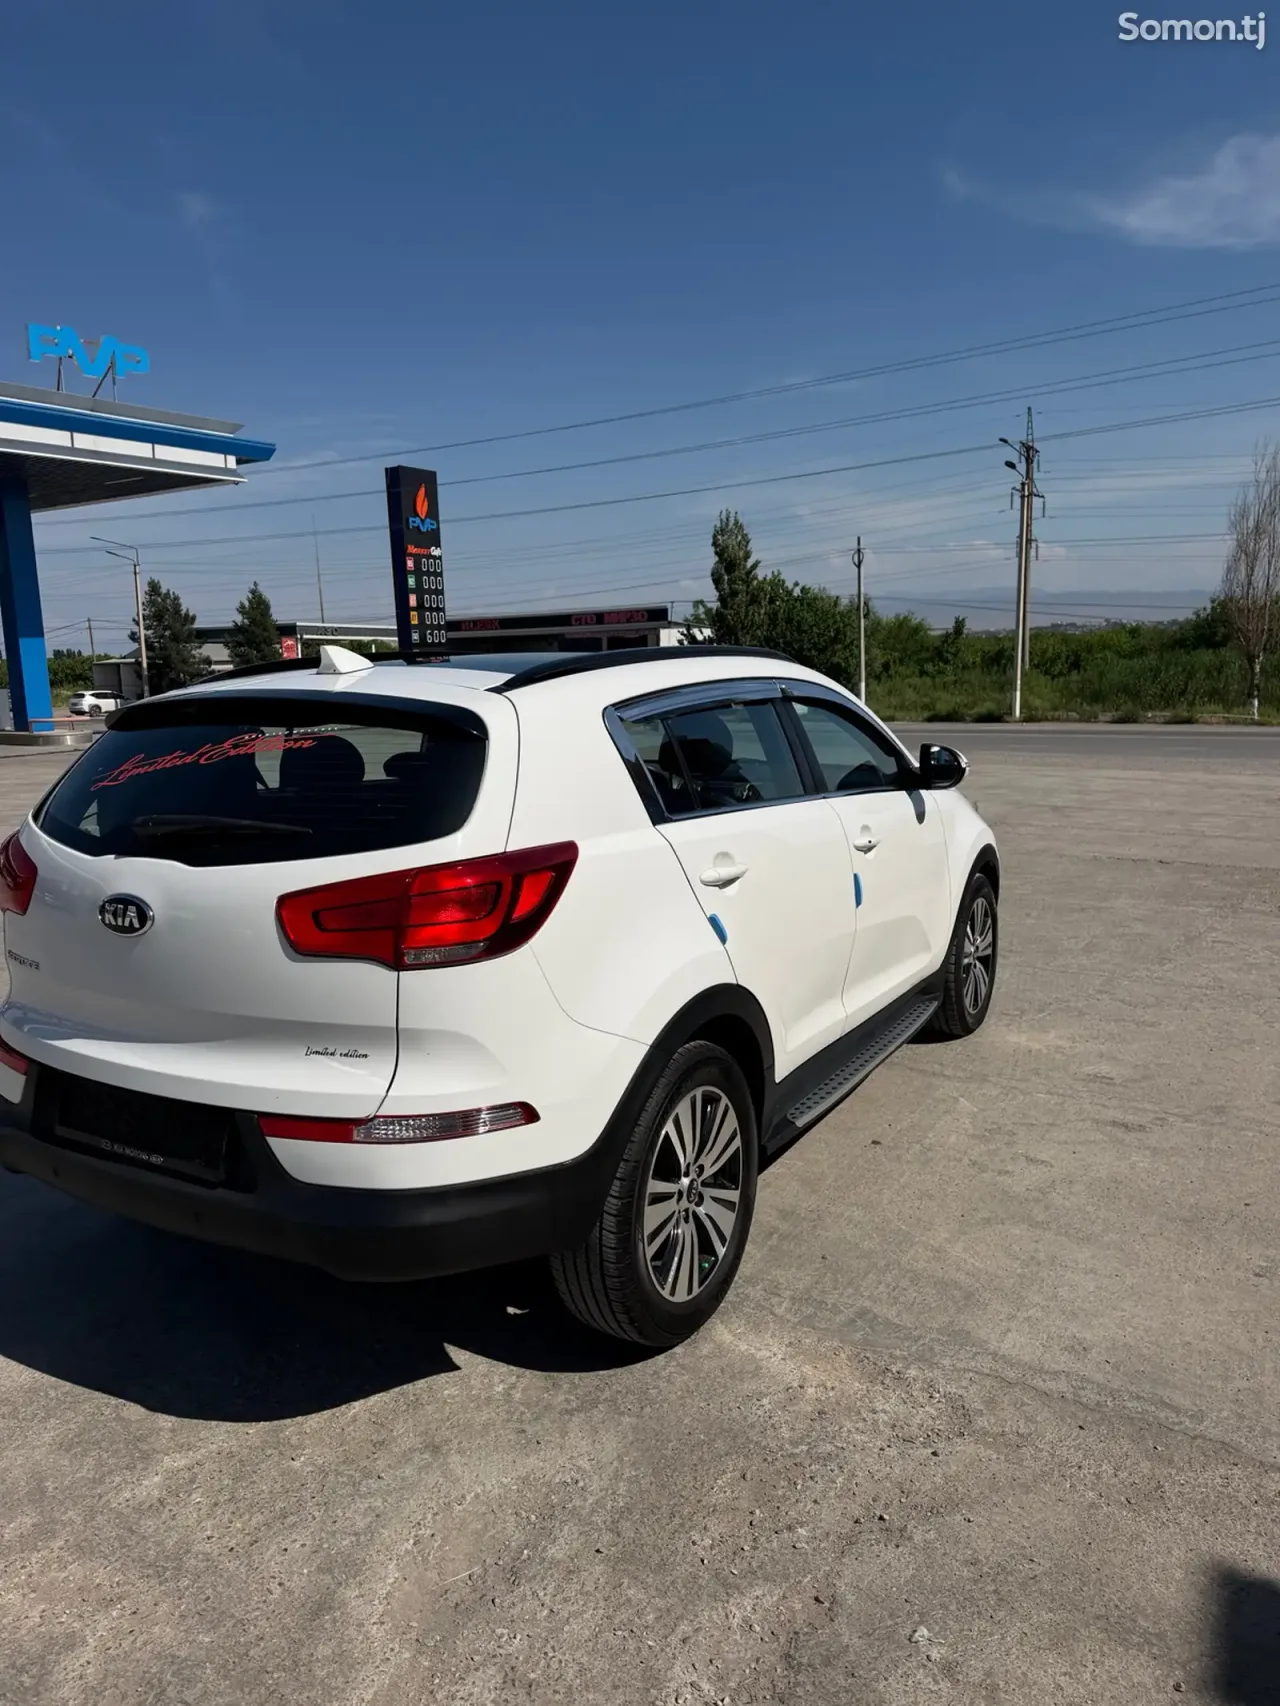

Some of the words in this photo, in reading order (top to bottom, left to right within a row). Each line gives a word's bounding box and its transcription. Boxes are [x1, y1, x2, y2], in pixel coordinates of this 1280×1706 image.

[27, 323, 150, 378] PVP
[408, 516, 437, 532] PVP
[91, 746, 207, 790] Limited
[199, 733, 336, 764] Edition
[104, 902, 140, 928] KIA
[304, 1046, 337, 1057] Limited
[339, 1048, 370, 1059] edition
